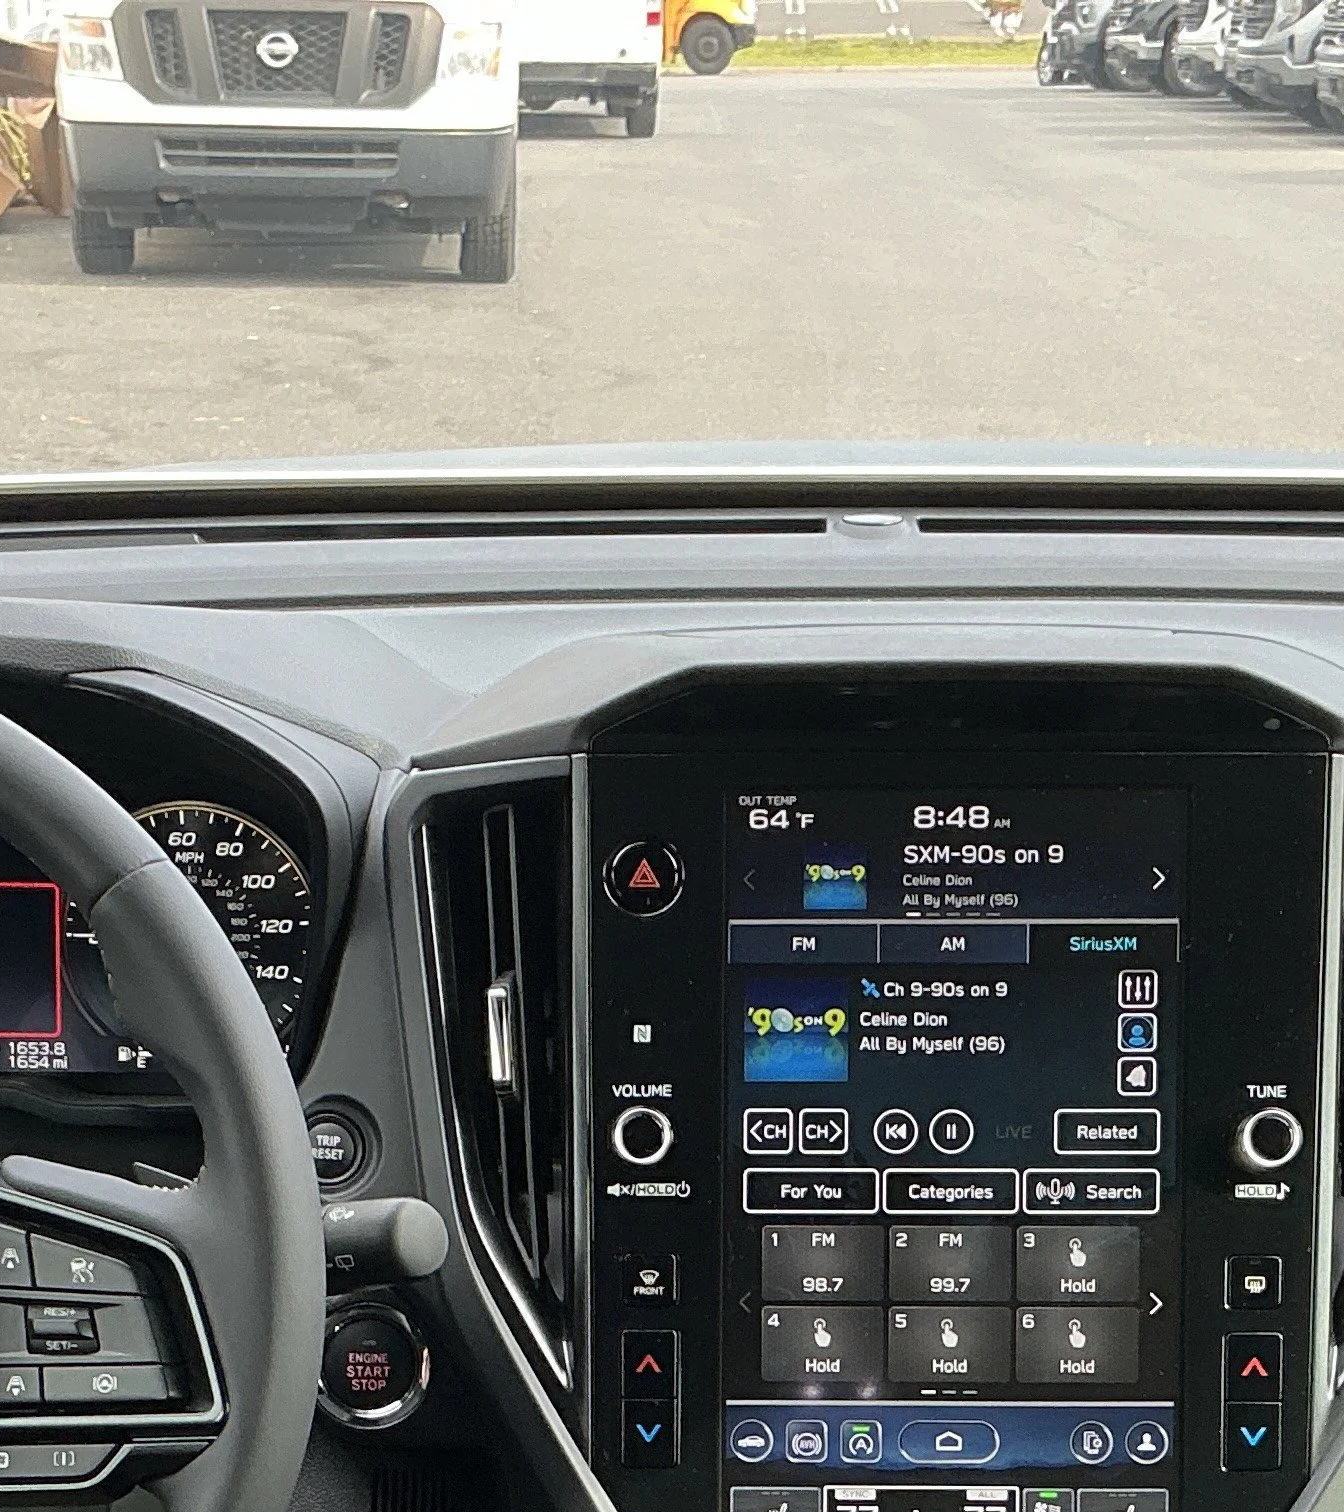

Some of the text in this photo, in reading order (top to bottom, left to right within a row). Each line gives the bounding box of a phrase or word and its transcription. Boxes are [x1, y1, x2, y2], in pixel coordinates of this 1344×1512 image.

[739, 796, 797, 806] OUT TEMP
[749, 809, 790, 829] 64
[913, 805, 1011, 829] 8:48 AM
[168, 832, 196, 847] 60
[215, 842, 244, 857] 80
[904, 845, 1065, 865] SXM-90s on 9
[175, 852, 205, 864] MPH
[241, 874, 276, 889] 100
[902, 874, 972, 886] Celine Dion
[902, 894, 1019, 908] All By Myself (96)
[259, 919, 294, 934] 120
[792, 937, 816, 951] FM
[940, 937, 966, 951] AM
[1069, 936, 1137, 952] SiriusXM
[255, 965, 290, 980] 140
[883, 982, 1008, 998] Ch 9-90s on 9
[823, 1007, 846, 1036] 9
[859, 1011, 948, 1027] Celine Dion
[8, 1041, 66, 1055] 1653.8
[859, 1036, 1006, 1055] All By Myself (96)
[8, 1055, 69, 1069] 1654 mi
[137, 1059, 147, 1069] E
[612, 1084, 673, 1097] VOLUME
[1246, 1084, 1288, 1098] TUNE
[763, 1123, 787, 1139] CH
[805, 1123, 829, 1139] CH
[994, 1124, 1033, 1139] LIVE
[1076, 1123, 1138, 1140] Related
[316, 1135, 341, 1147] TRIP
[312, 1148, 344, 1161] RESET
[636, 1183, 675, 1196] HOLD
[780, 1183, 843, 1200] For You
[907, 1182, 994, 1204] Categories
[1085, 1182, 1142, 1201] Search
[1236, 1184, 1275, 1197] HOLD
[770, 1233, 836, 1248] 1 FM
[895, 1233, 963, 1249] 2 FM
[1023, 1233, 1035, 1249] 3
[633, 1286, 665, 1296] FRONT
[802, 1277, 845, 1293] 98.7
[929, 1277, 972, 1293] 99.7
[1059, 1277, 1096, 1294] Hold
[767, 1313, 780, 1328] 4
[894, 1313, 907, 1328] 5
[1022, 1313, 1035, 1329] 6
[348, 1353, 389, 1364] ENGINE
[804, 1357, 841, 1374] Hold
[932, 1357, 968, 1374] Hold
[1059, 1357, 1096, 1374] Hold
[346, 1365, 391, 1378] START
[351, 1379, 387, 1391] STOP
